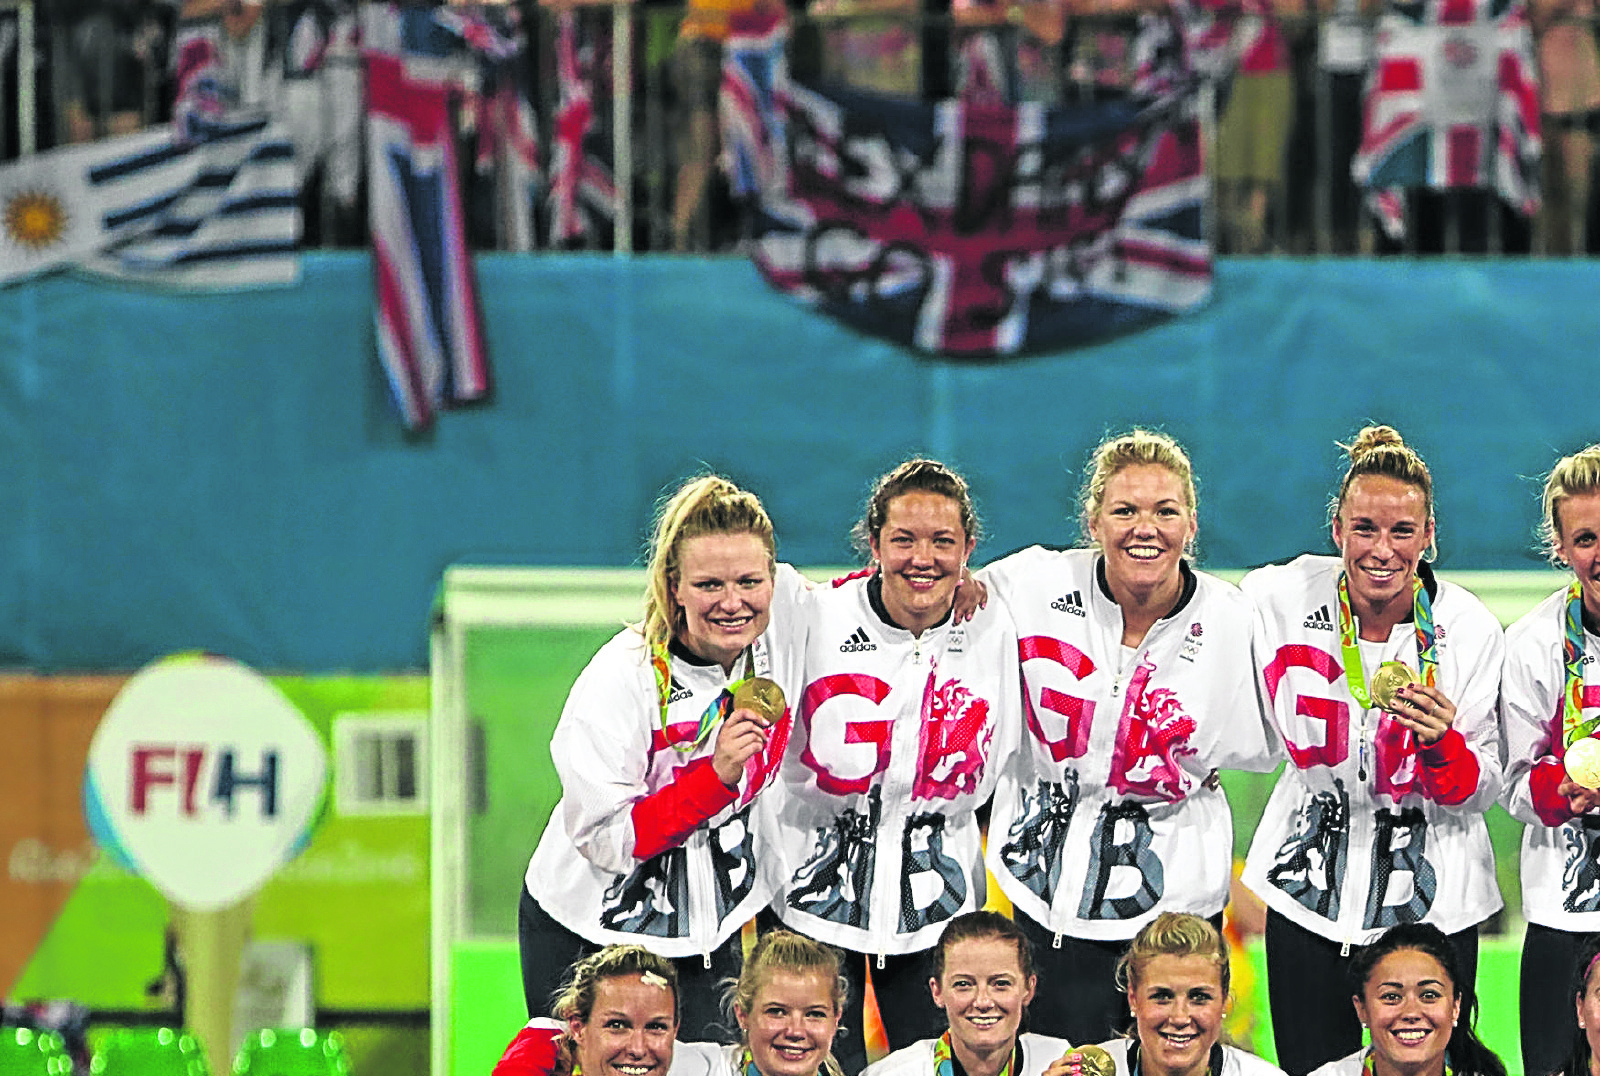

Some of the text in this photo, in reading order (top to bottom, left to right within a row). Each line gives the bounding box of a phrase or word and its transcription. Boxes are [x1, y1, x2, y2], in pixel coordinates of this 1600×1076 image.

[839, 642, 878, 654] adidas
[1050, 600, 1087, 619] adidas
[1303, 619, 1334, 632] adidas
[802, 673, 897, 796] G
[1018, 635, 1098, 763] G
[1264, 644, 1350, 769] G
[129, 744, 278, 817] FIH
[896, 812, 967, 934] B
[1077, 800, 1165, 921] B
[1362, 808, 1438, 930] B
